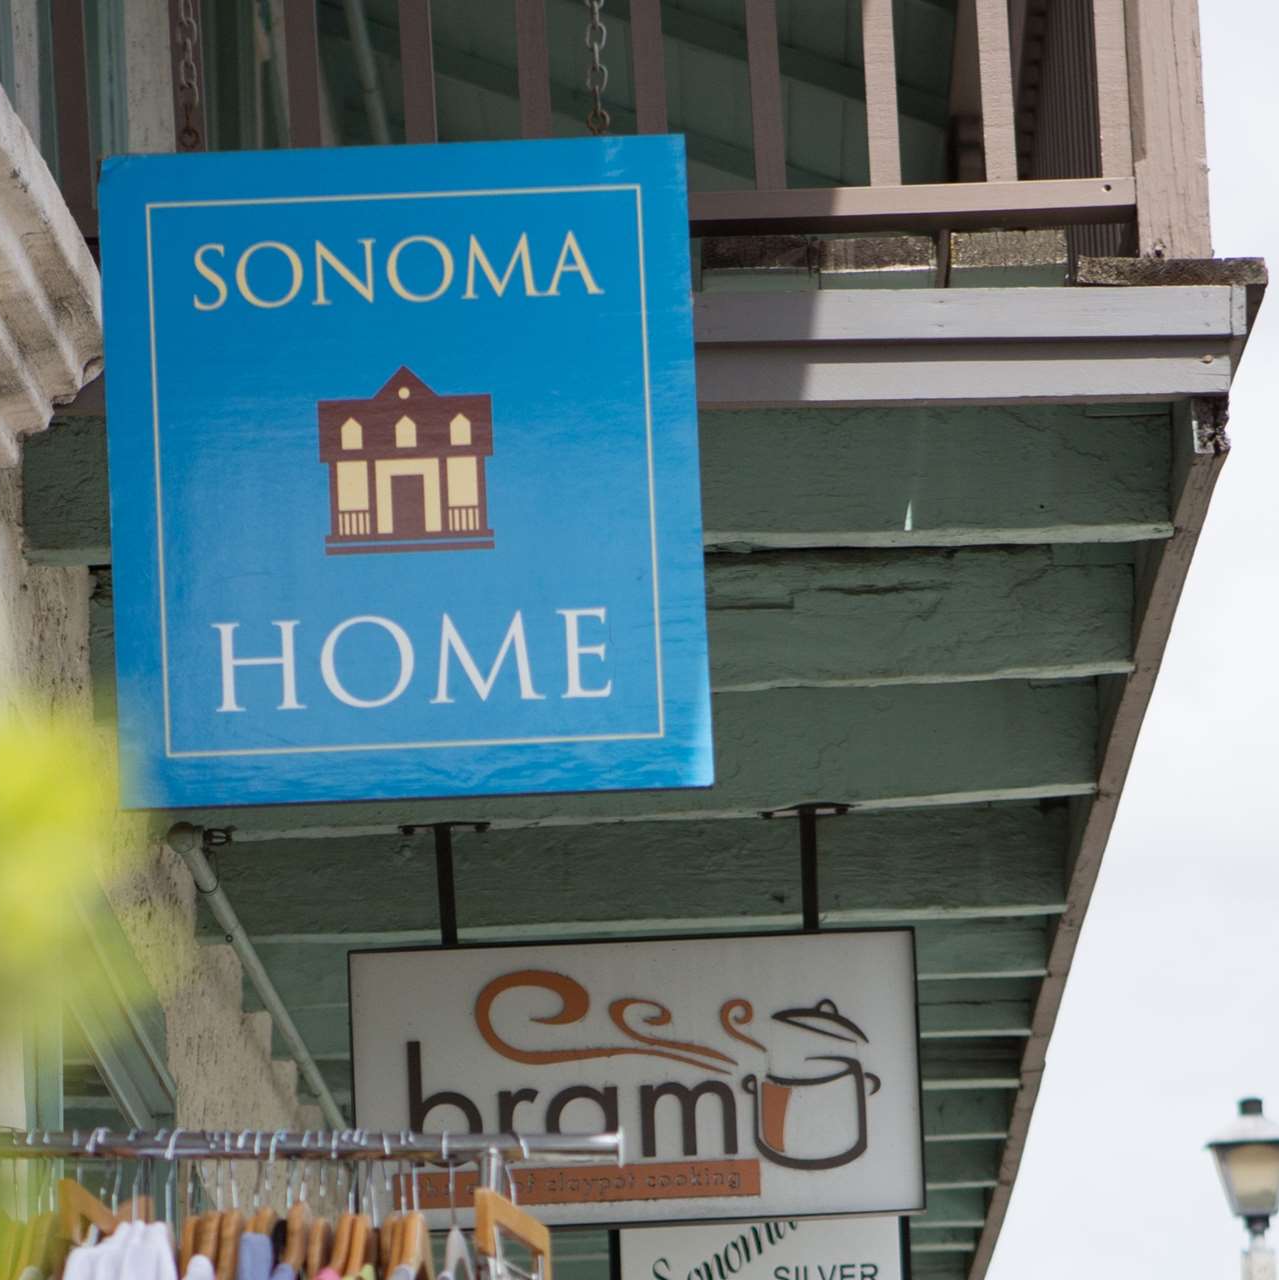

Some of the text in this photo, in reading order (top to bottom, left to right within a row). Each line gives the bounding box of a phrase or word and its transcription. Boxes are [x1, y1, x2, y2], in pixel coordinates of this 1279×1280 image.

[192, 230, 605, 311] SONOMA
[212, 606, 615, 712] HOME
[406, 1041, 738, 1168] bram
[645, 1166, 742, 1190] cooking
